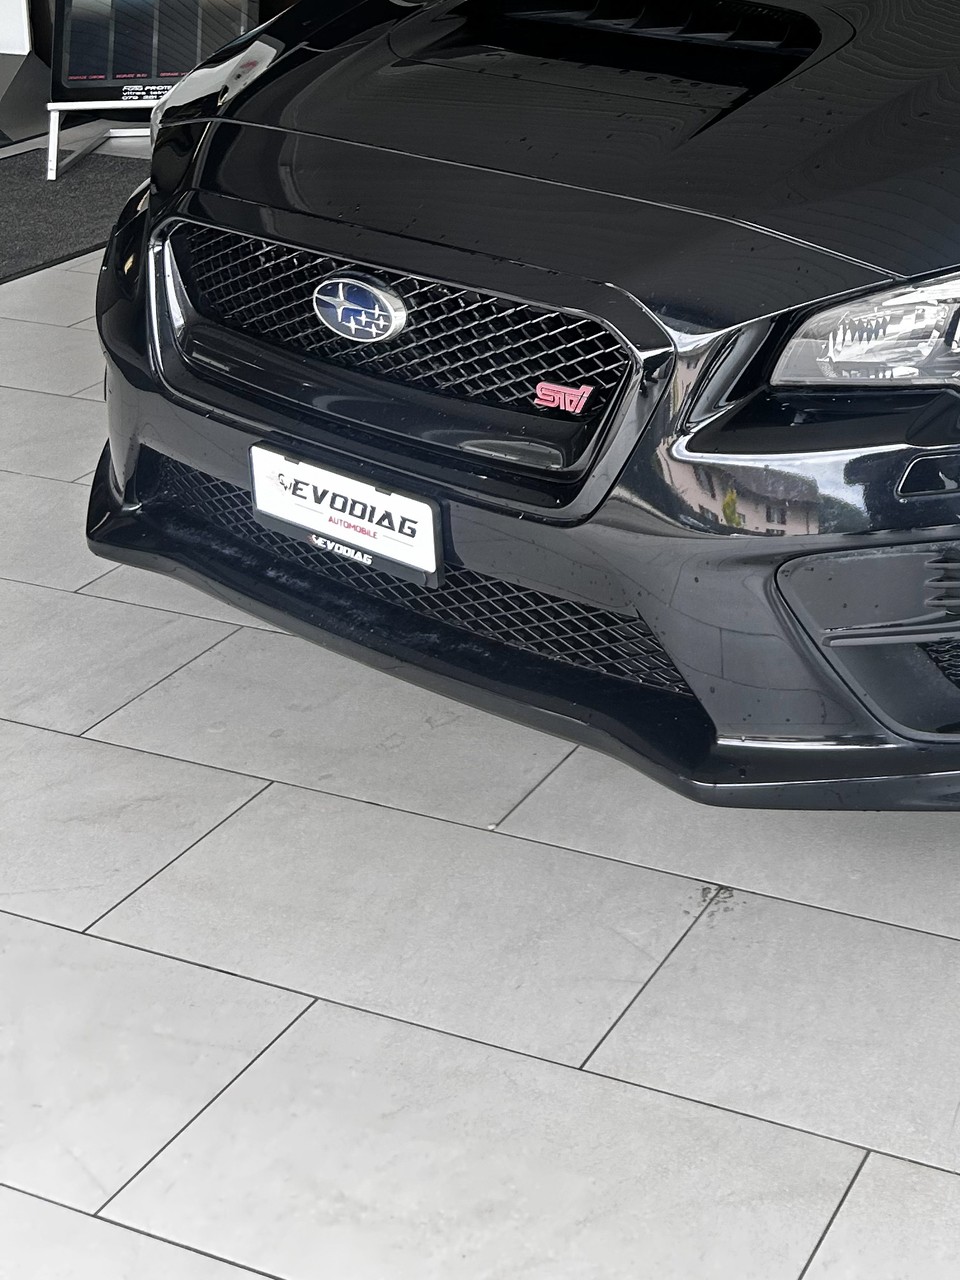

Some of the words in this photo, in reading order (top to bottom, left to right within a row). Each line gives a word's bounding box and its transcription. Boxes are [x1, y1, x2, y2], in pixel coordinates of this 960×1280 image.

[533, 381, 594, 414] STI
[291, 478, 419, 539] EVODIAG
[328, 516, 379, 540] AUTOMOBILE
[318, 535, 373, 566] EVODIAG
